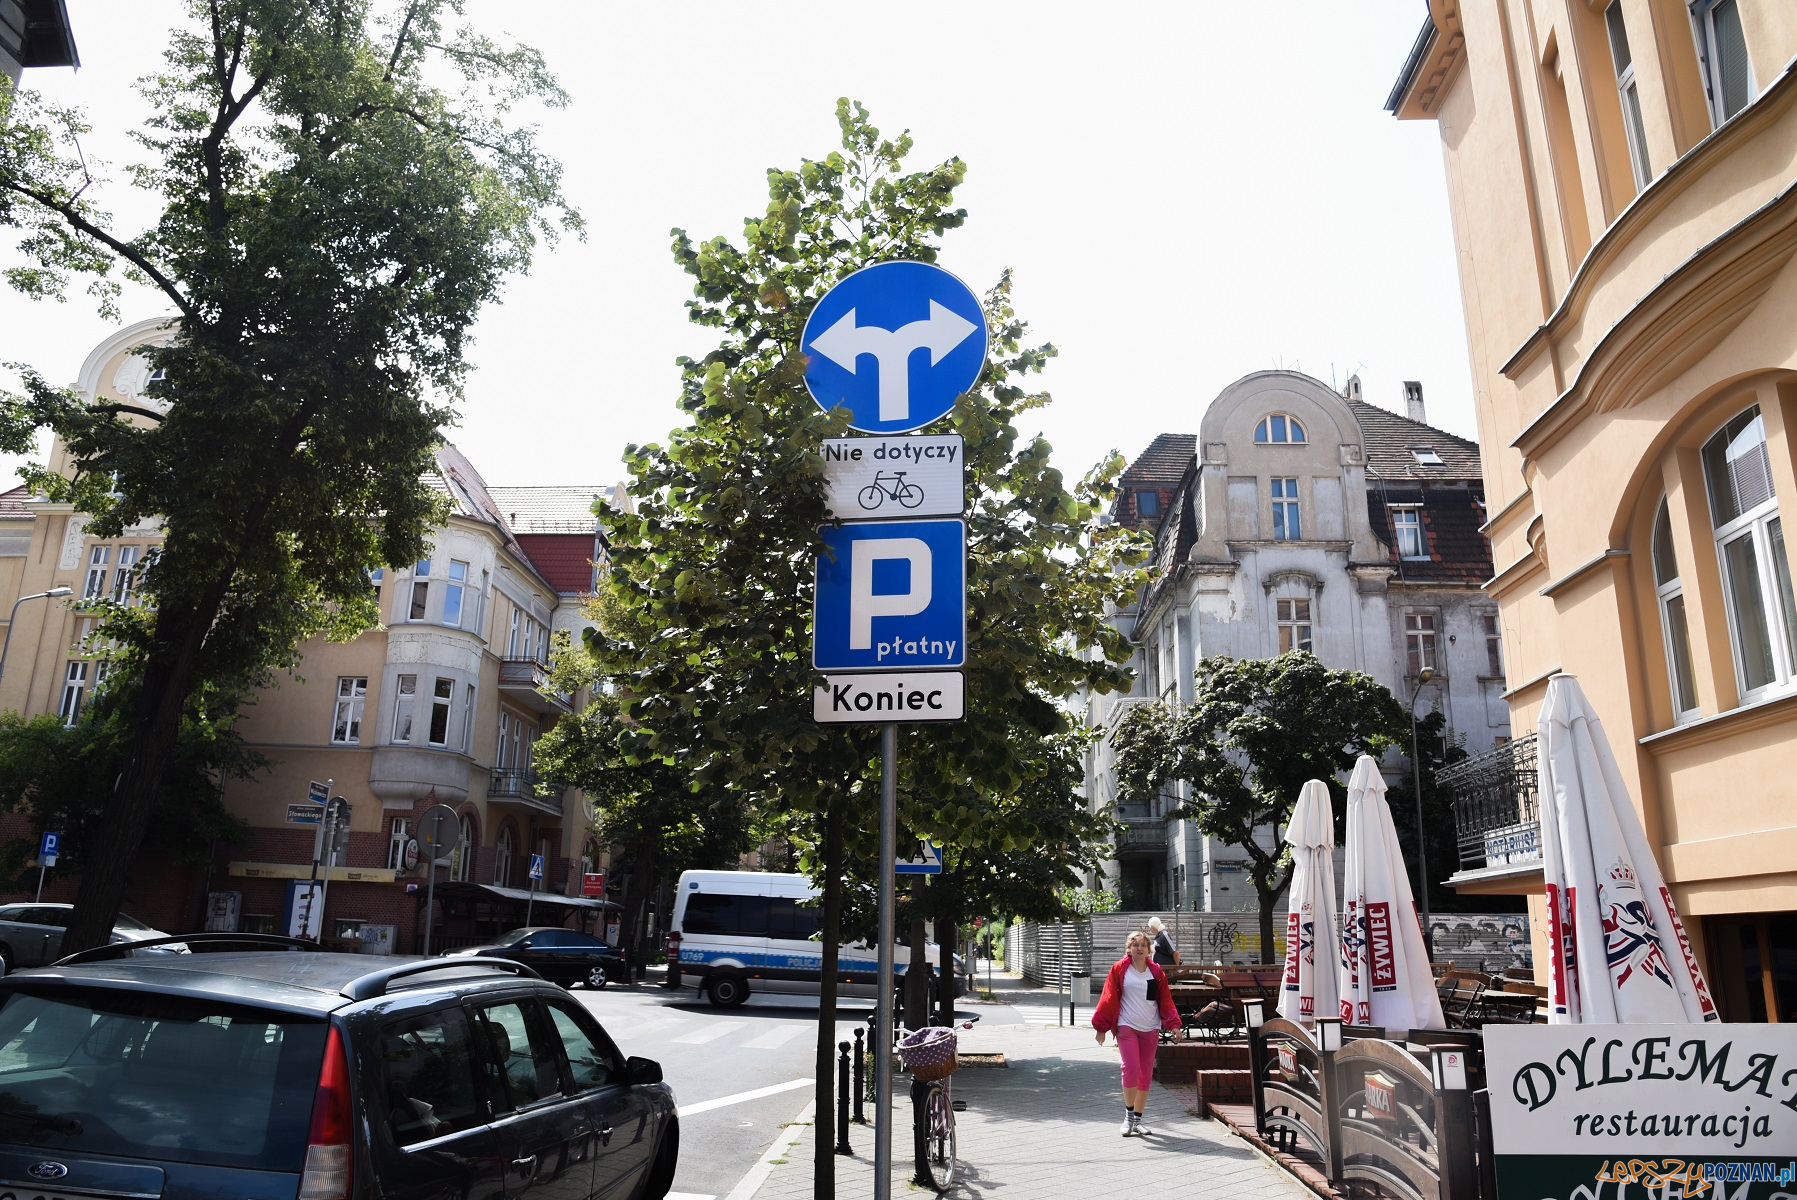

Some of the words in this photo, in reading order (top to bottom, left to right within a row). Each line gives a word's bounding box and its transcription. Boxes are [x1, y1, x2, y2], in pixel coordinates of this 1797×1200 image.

[826, 444, 863, 462] Nie
[873, 442, 958, 464] dotyczy
[850, 538, 932, 650] P
[877, 636, 957, 661] płatny
[833, 683, 943, 712] Koniec
[681, 952, 705, 961] U769
[1369, 907, 1392, 980] ŻYWIEC
[1573, 1106, 1773, 1149] restauracja
